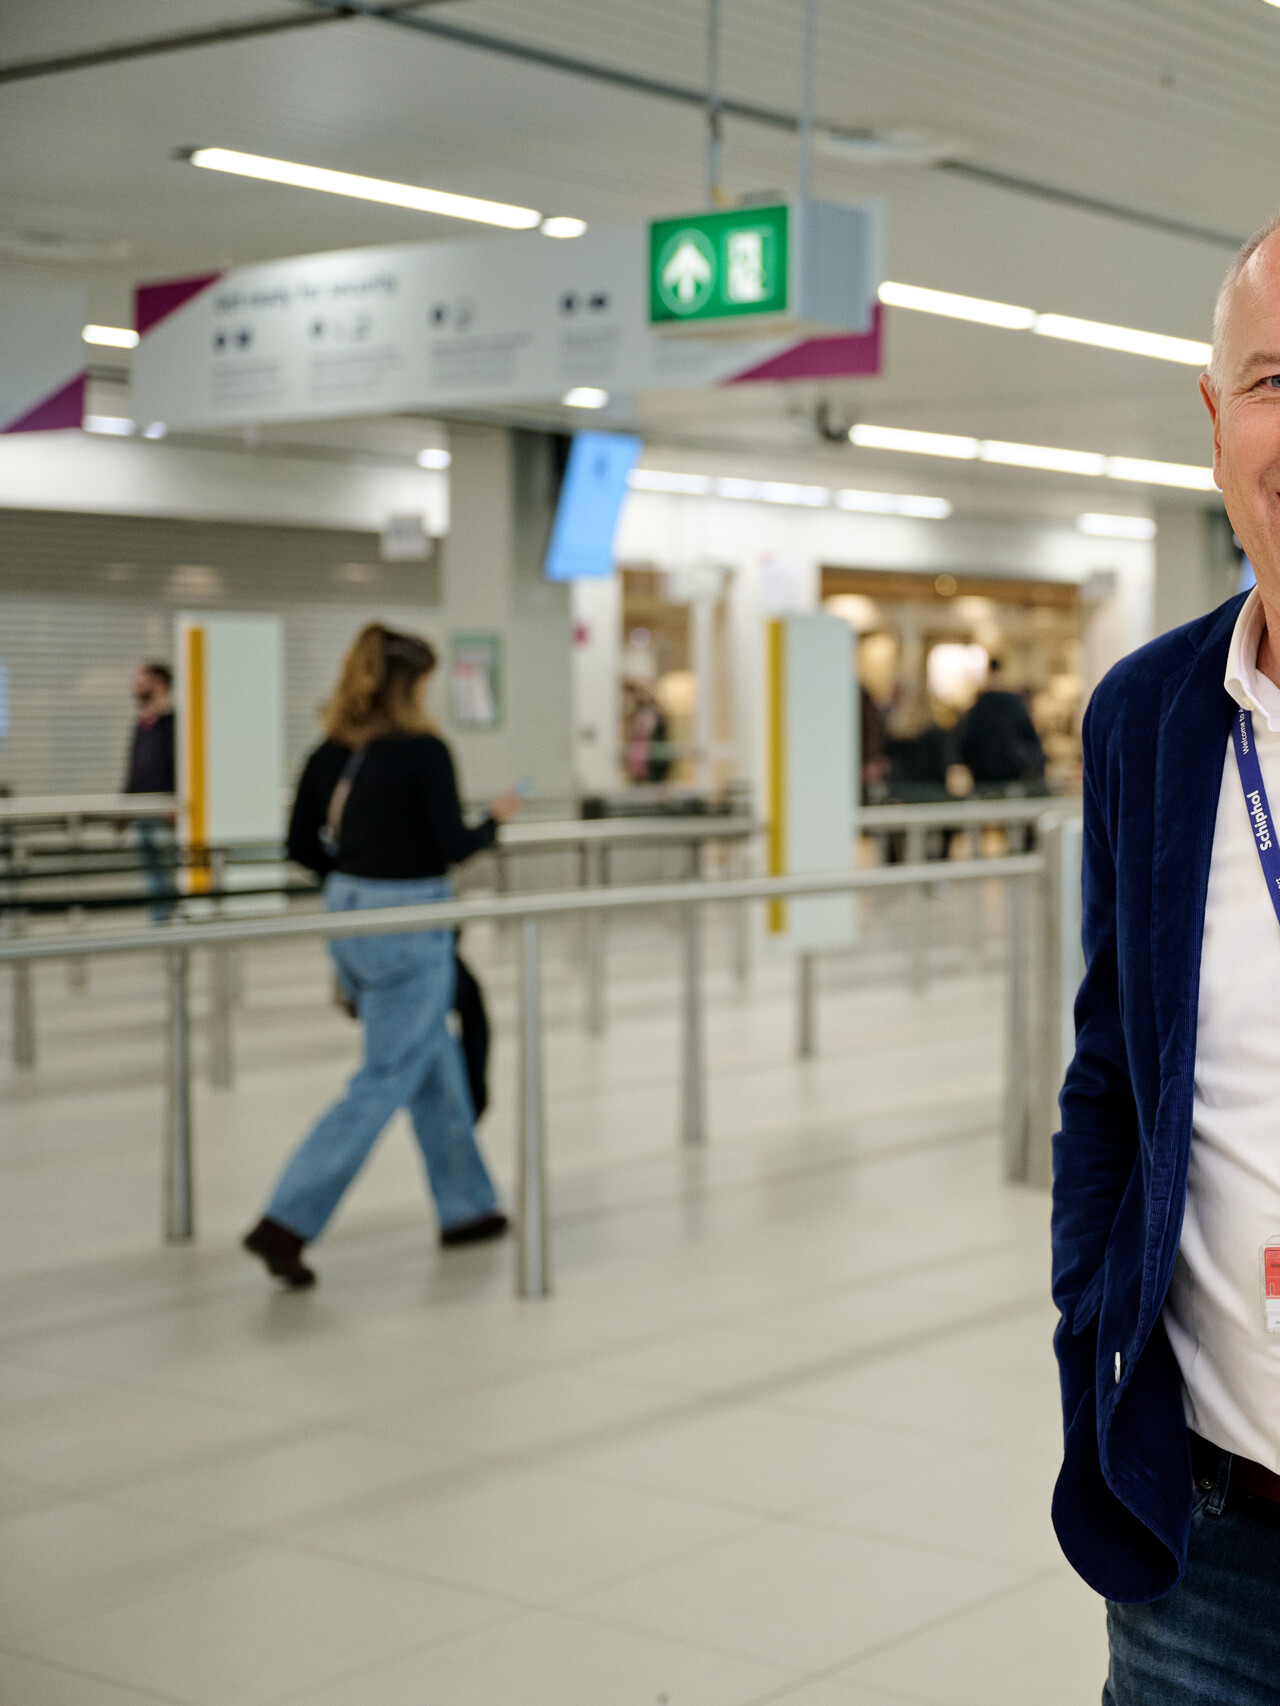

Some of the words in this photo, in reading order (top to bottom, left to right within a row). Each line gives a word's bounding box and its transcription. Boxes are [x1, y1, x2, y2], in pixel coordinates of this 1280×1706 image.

[1239, 713, 1245, 722] to
[1240, 721, 1250, 755] Welcome
[1246, 790, 1273, 851] Schiphol
